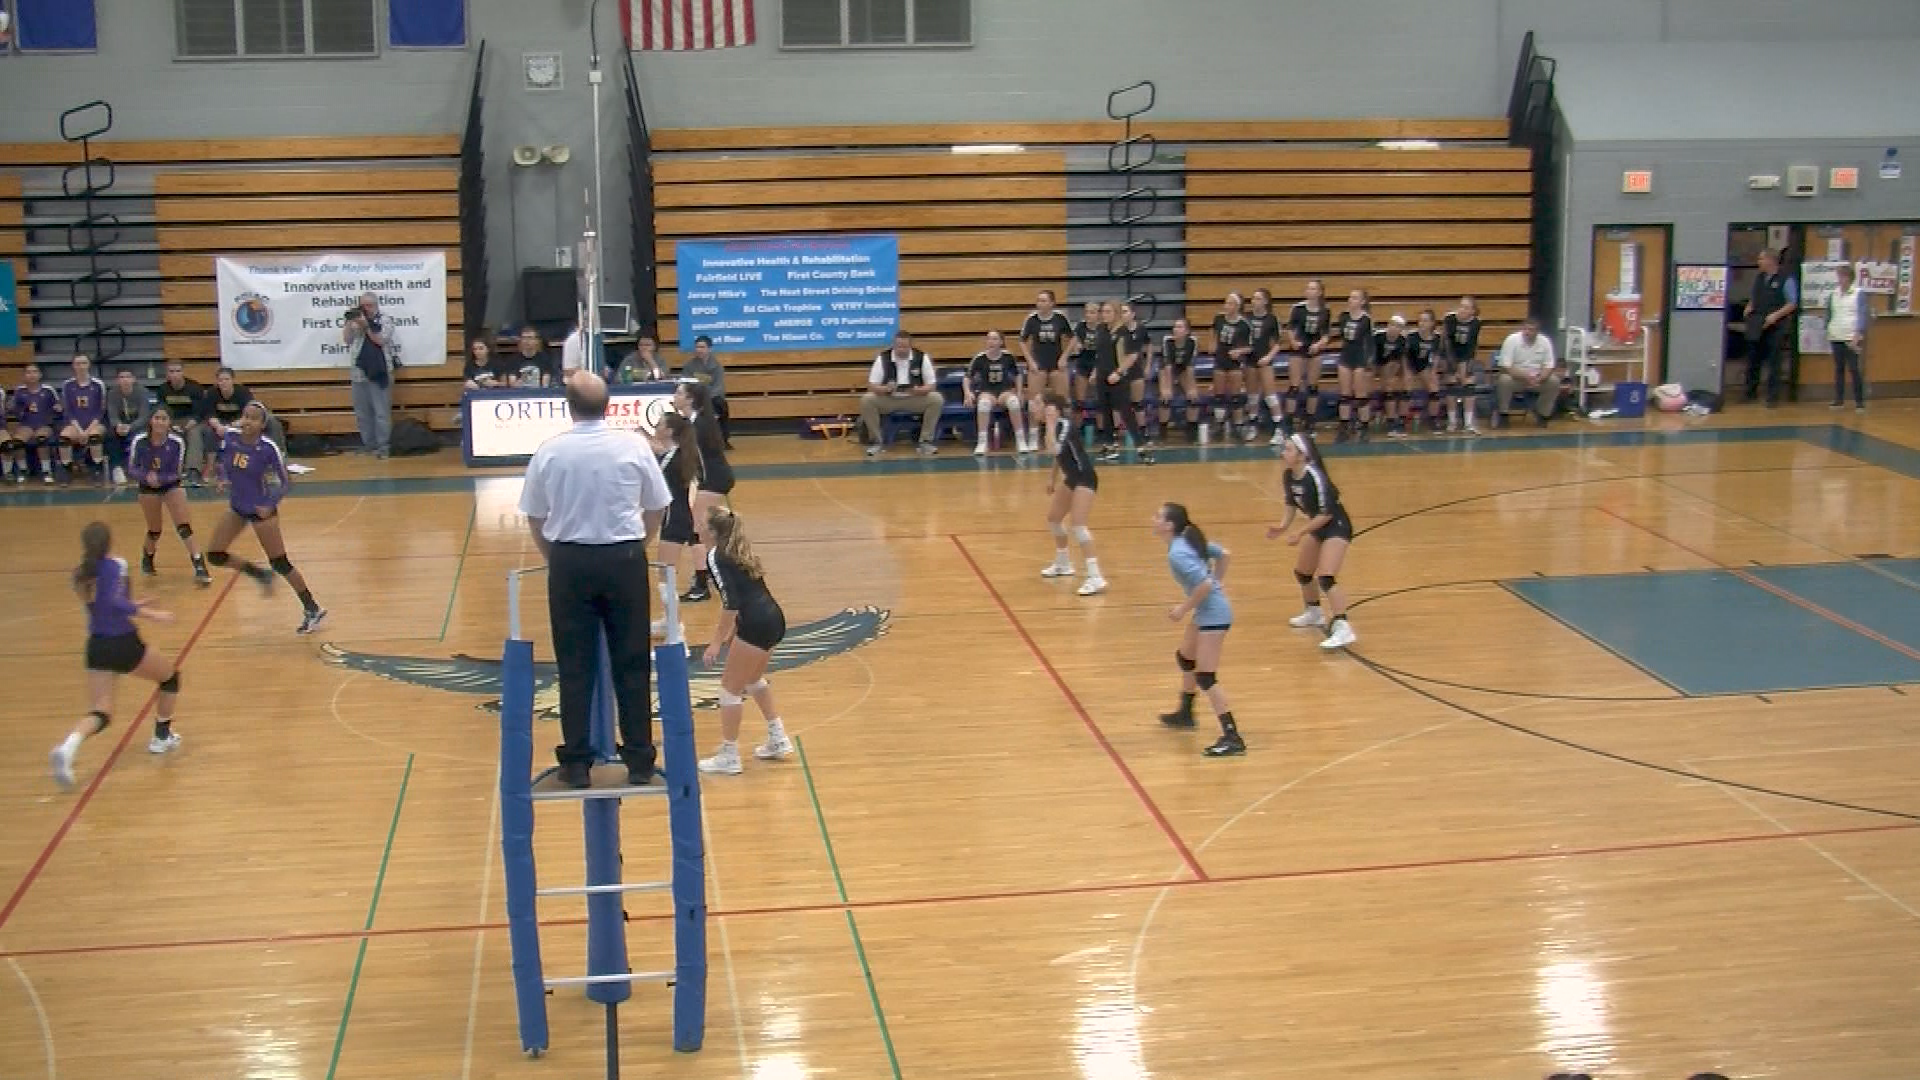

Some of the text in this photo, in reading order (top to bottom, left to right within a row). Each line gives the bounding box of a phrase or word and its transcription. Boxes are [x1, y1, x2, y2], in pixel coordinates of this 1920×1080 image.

[702, 254, 870, 268] Innovative Health & Rehabilitation
[248, 265, 280, 275] Thank
[282, 265, 302, 274] You
[305, 265, 318, 273] To
[320, 263, 338, 273] Our
[342, 263, 371, 274] Major
[787, 269, 875, 280] First County Bank
[695, 271, 762, 282] Fairfield LIVE
[283, 277, 431, 293] Innovative Health and
[760, 288, 777, 297] The
[803, 287, 830, 296] Street
[831, 286, 864, 296] Driving
[865, 285, 896, 295] School
[312, 294, 405, 307] Rehabiltion
[302, 317, 332, 329] First
[762, 333, 780, 342] The
